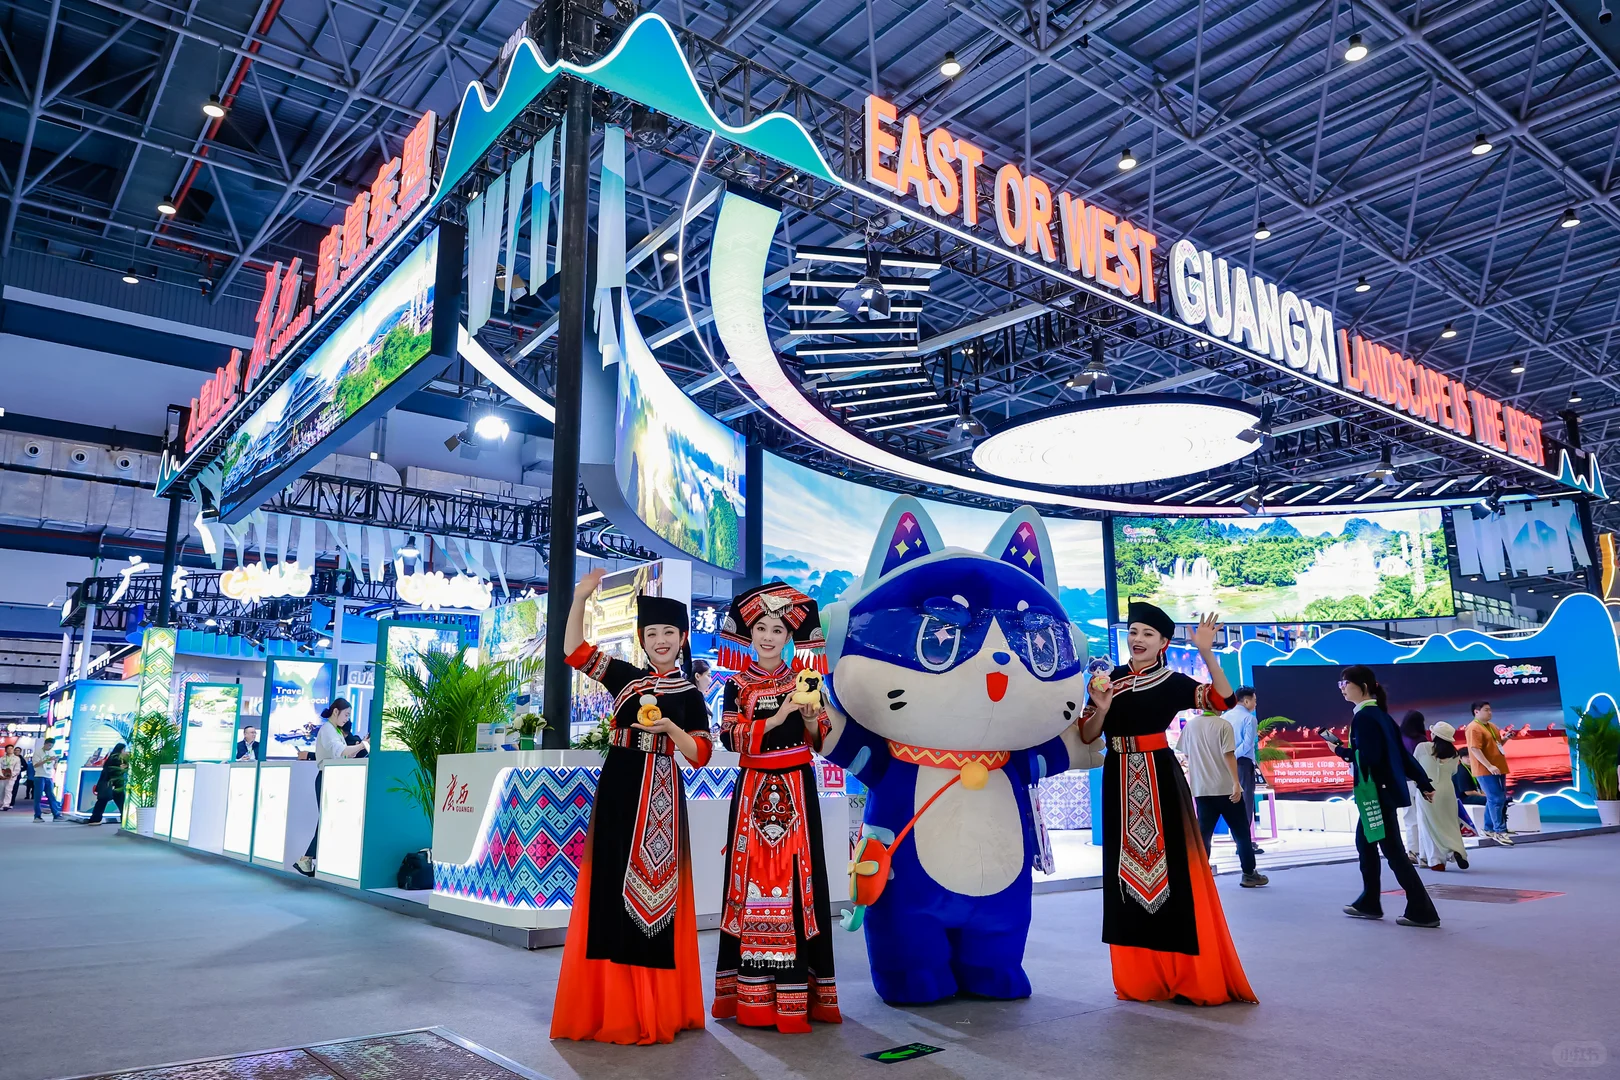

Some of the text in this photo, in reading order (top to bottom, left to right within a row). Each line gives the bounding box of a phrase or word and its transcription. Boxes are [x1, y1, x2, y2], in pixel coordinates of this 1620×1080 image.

[864, 93, 1545, 466] EAST OR WEST GUANGXI LANDSCAPE IS THE BEST
[270, 305, 312, 360] GUANGXI
[275, 686, 305, 695] Travel
[456, 805, 474, 813] GUANGXI
